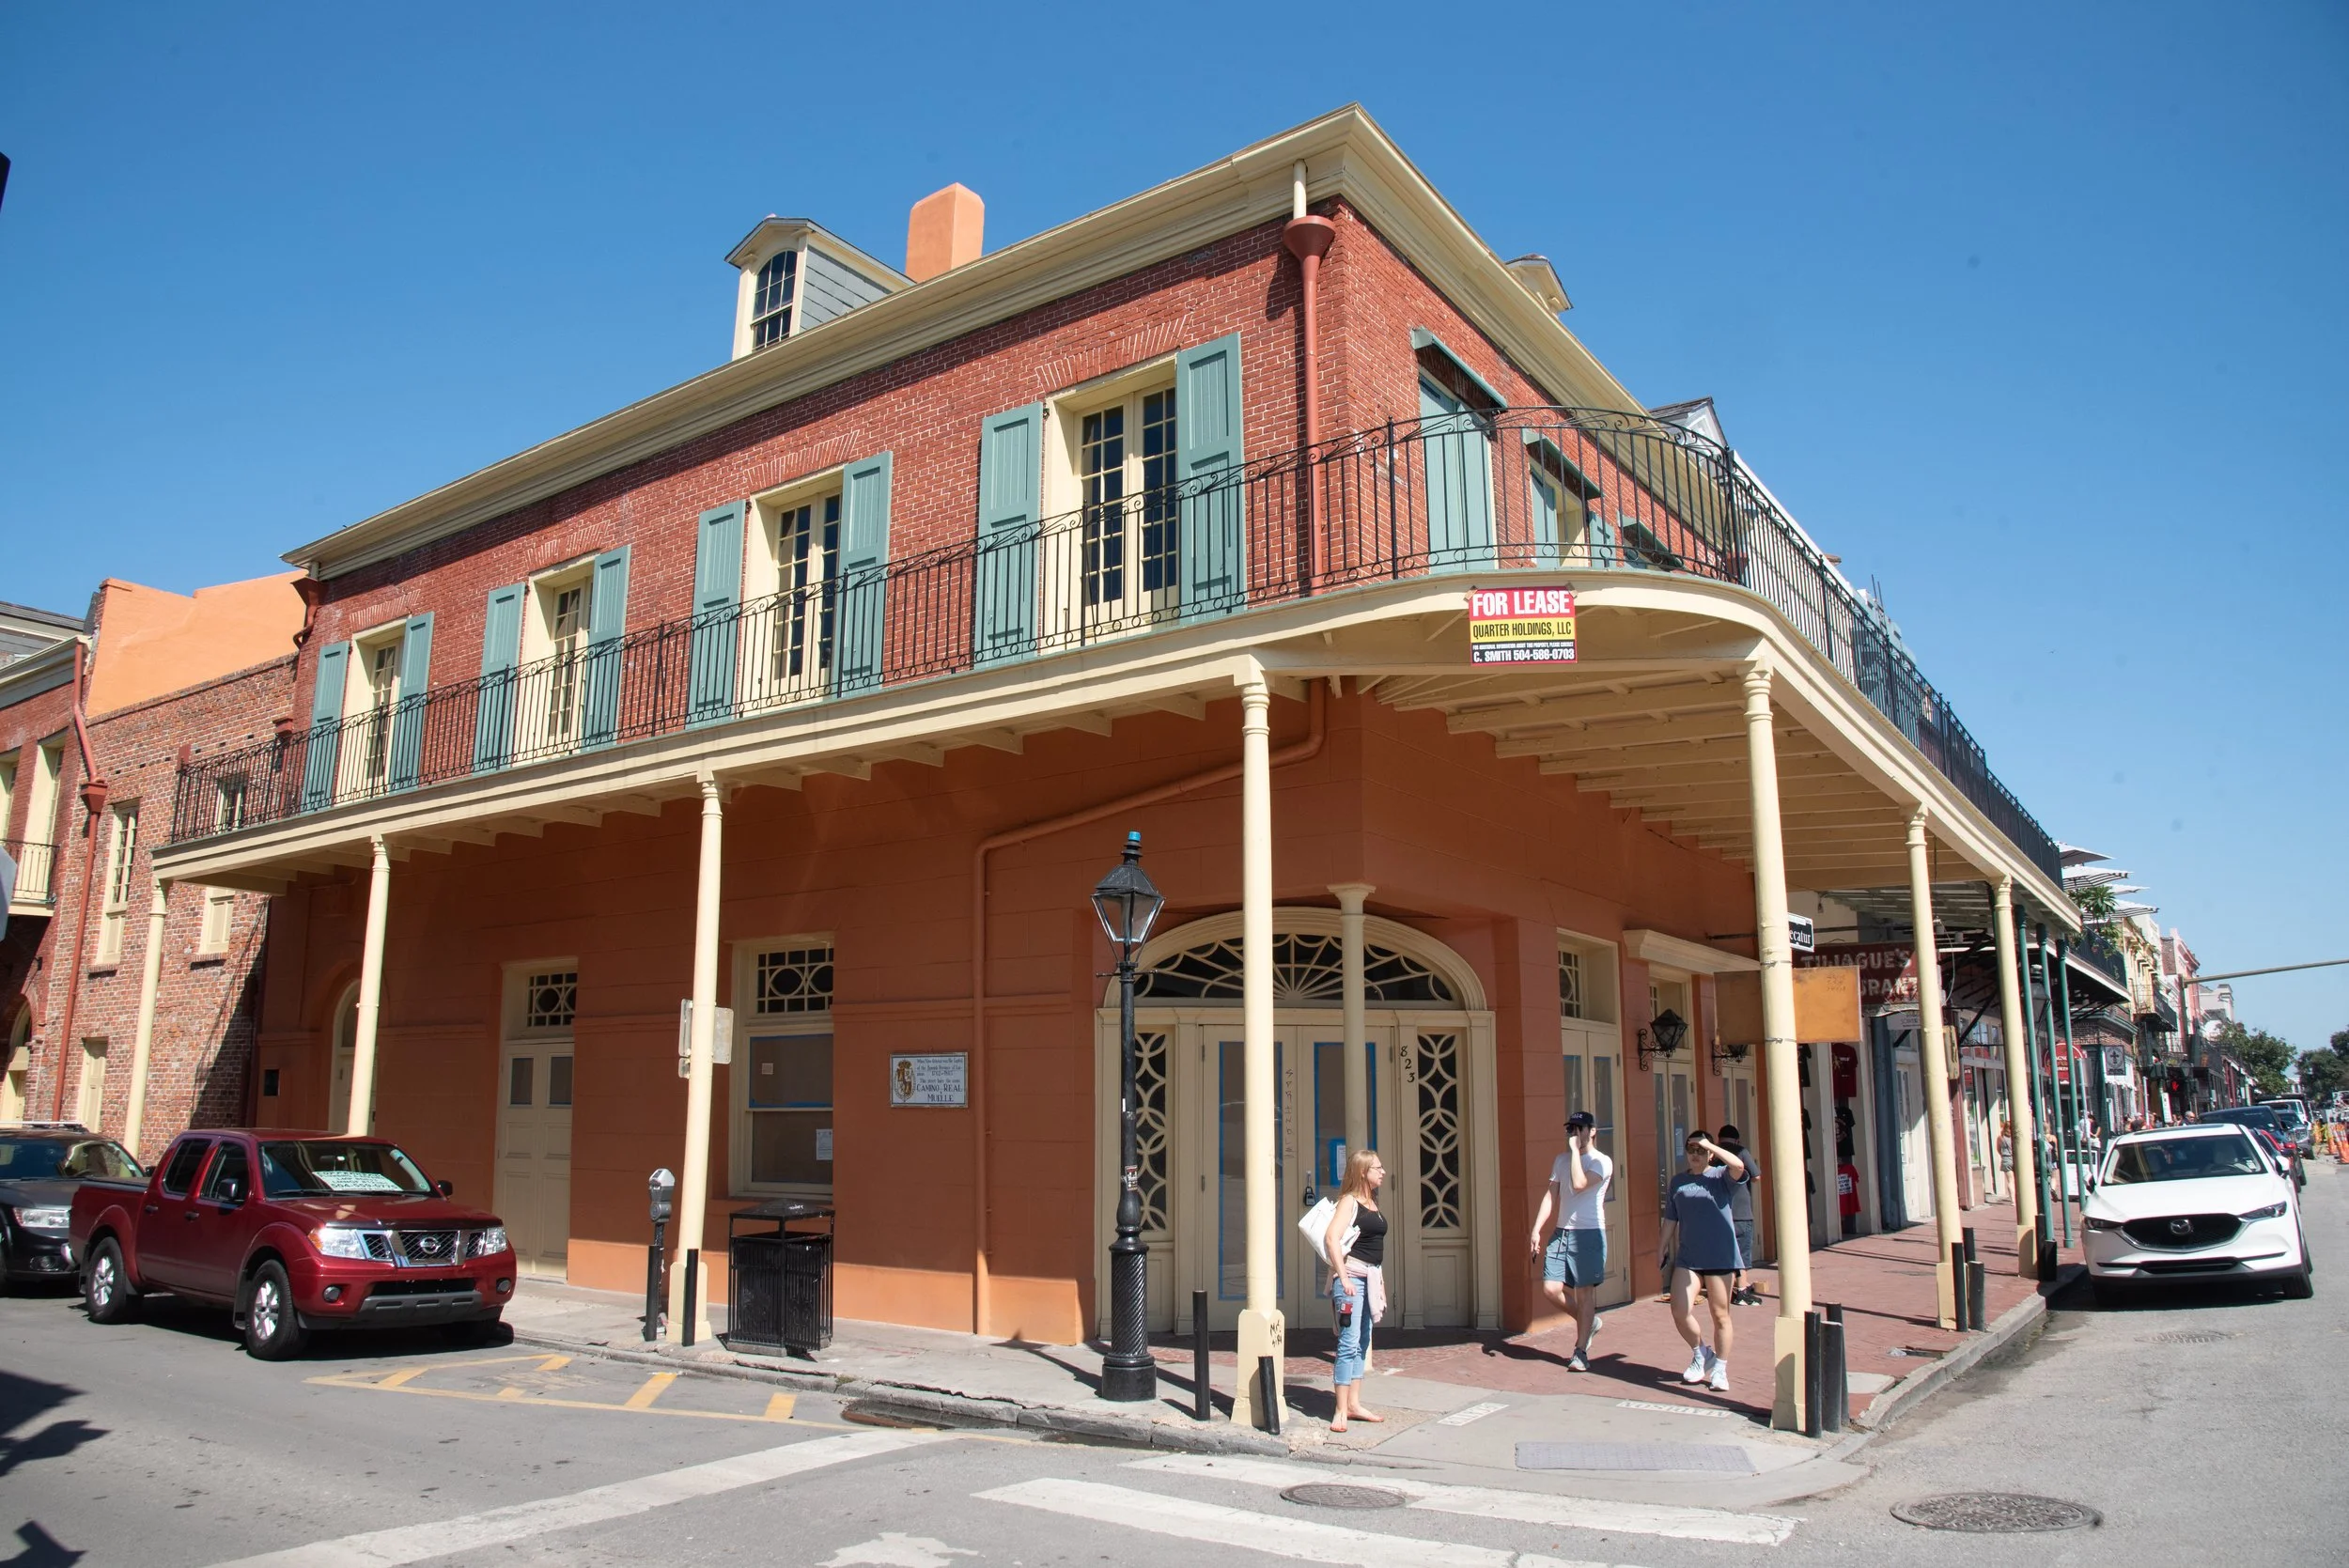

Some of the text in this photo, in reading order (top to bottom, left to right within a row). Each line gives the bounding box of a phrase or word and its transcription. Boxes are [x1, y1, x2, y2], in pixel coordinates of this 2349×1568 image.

[1472, 591, 1570, 616] FOR LEASE
[1473, 622, 1571, 639] QUARTER HOLDINGS, LLC
[1473, 651, 1482, 662] C.
[1485, 650, 1511, 661] SMITH
[1789, 930, 1811, 944] ecatur
[917, 1083, 963, 1092] CAMINO REAL
[927, 1094, 954, 1102] MUELLE
